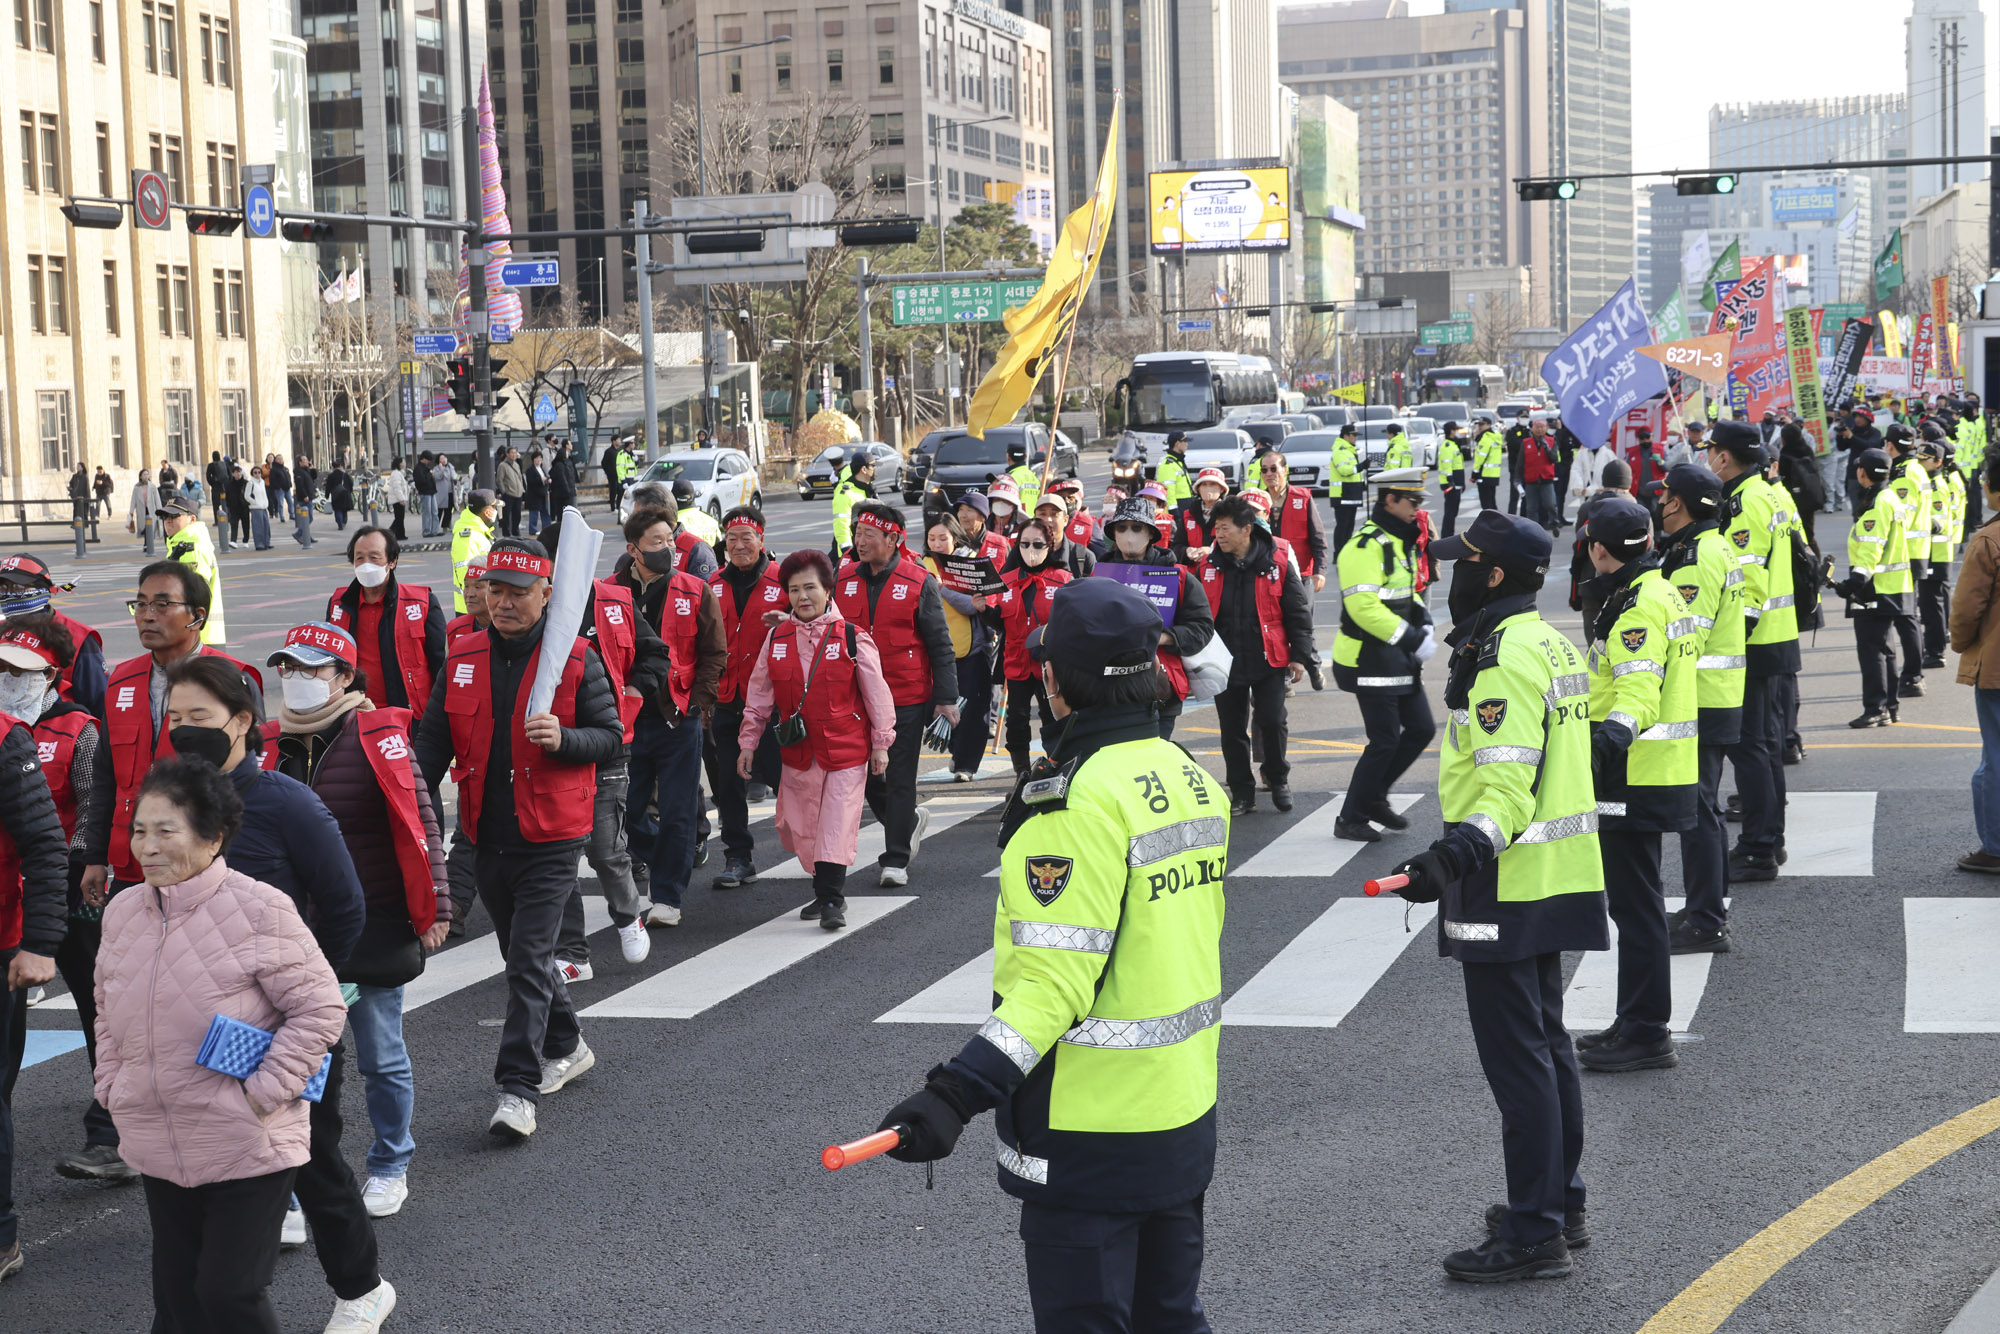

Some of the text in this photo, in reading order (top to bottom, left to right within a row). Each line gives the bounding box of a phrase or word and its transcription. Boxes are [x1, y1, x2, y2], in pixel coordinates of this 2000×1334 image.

[1775, 194, 1835, 211] 기프트인포
[536, 264, 555, 275] 종로
[530, 276, 555, 284] Jong-ro
[908, 287, 940, 298] 숭례문
[910, 305, 926, 316] 시청
[911, 315, 923, 323] City
[348, 343, 383, 363] STUDIO
[1666, 346, 1723, 368] 62기-3
[1912, 360, 1925, 390] 반대
[491, 553, 542, 573] 결사반대
[1203, 567, 1216, 583] 투
[763, 585, 782, 602] 쟁
[843, 580, 909, 601] 투 쟁
[1148, 584, 1167, 595] 없는
[330, 603, 423, 622] 투 쟁
[604, 604, 625, 625] 쟁
[674, 597, 692, 616] 쟁
[288, 627, 346, 653] 결사반대
[772, 642, 842, 661] 투 쟁
[452, 663, 475, 688] 투
[115, 686, 136, 712] 투
[37, 741, 58, 763] 쟁
[377, 733, 408, 760] 쟁
[1146, 856, 1226, 903] POLIC
[1036, 887, 1055, 896] POLICE
